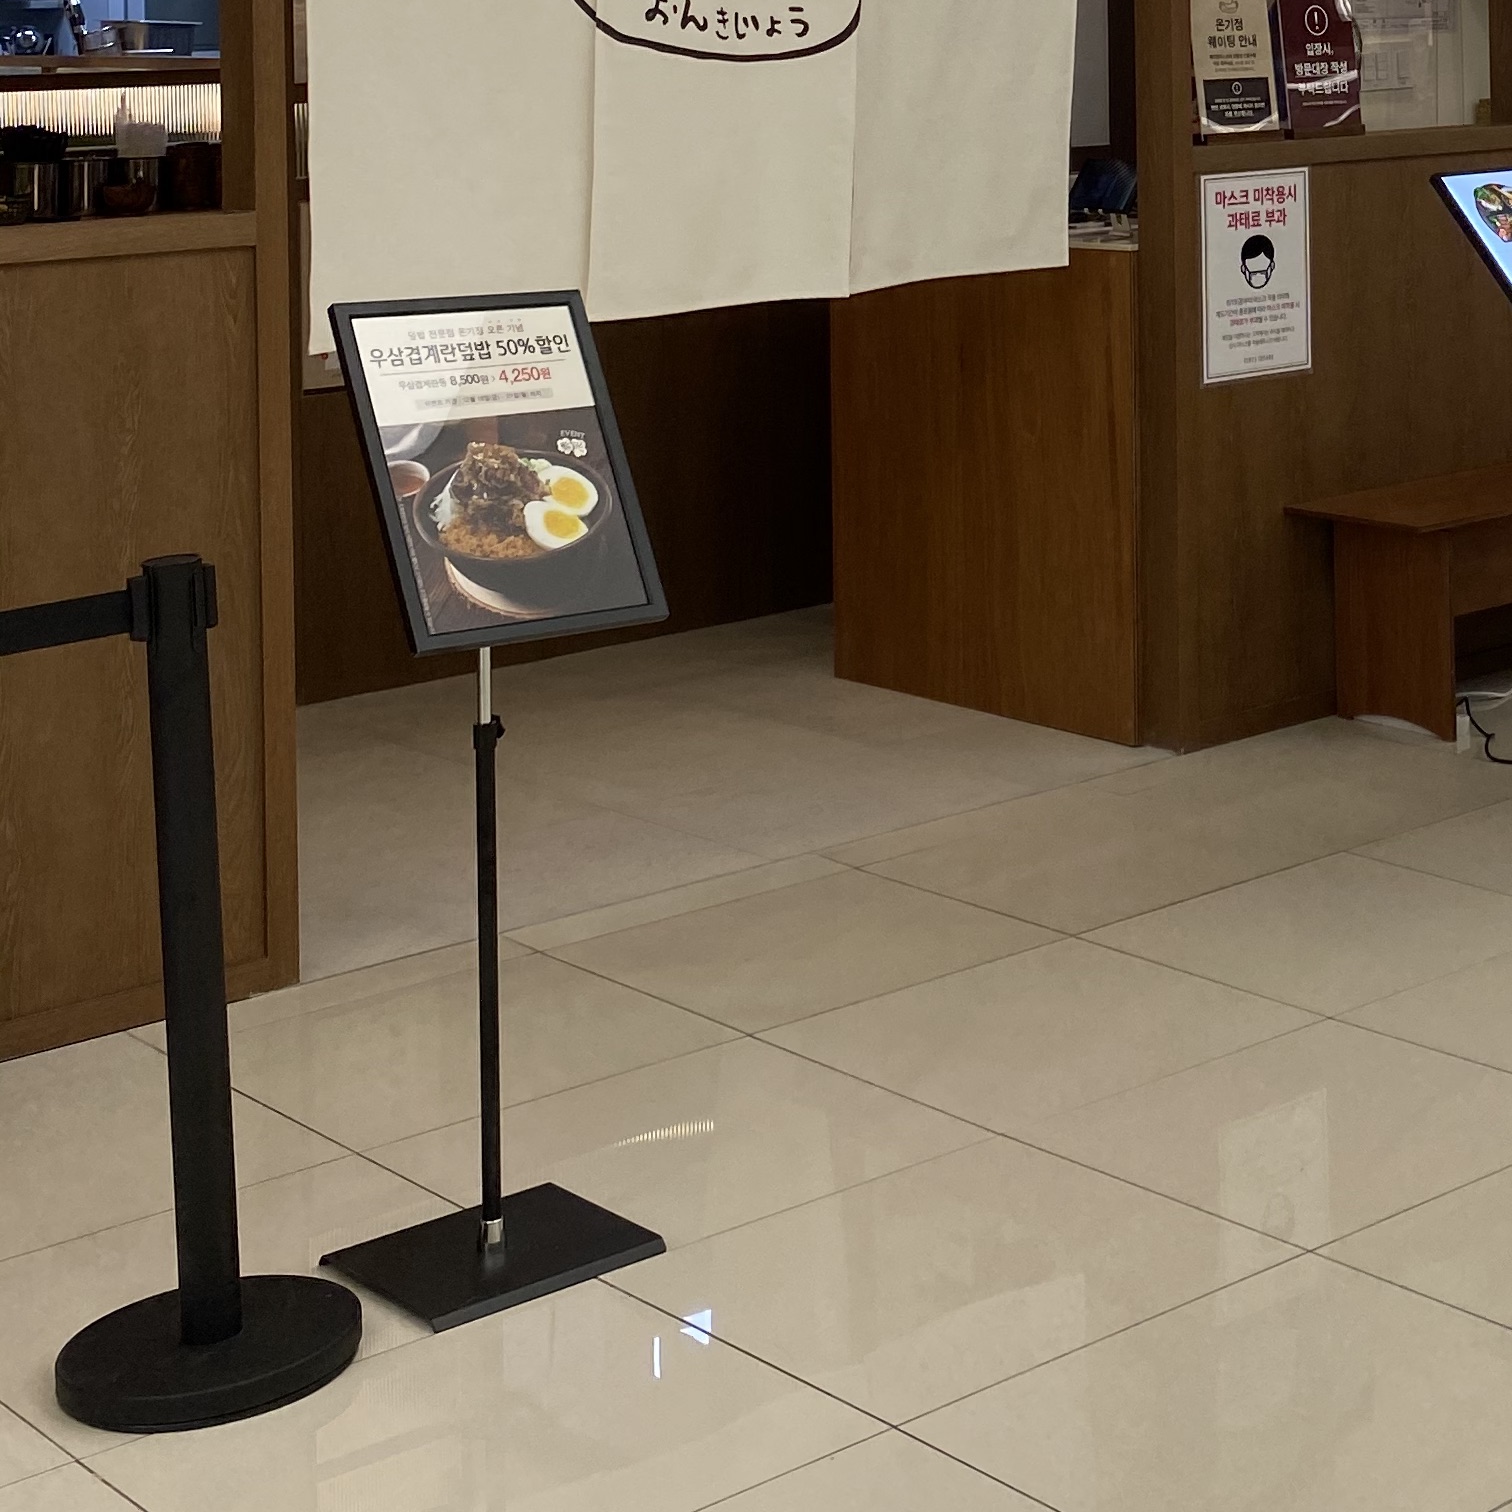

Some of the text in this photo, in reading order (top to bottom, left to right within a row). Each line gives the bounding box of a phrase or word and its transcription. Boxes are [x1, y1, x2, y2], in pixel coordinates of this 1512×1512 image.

[1216, 18, 1243, 32] 온기정
[1207, 34, 1257, 48] 웨이팅 안내
[1330, 61, 1348, 74] 작성
[1215, 184, 1297, 209] 마스크 미착용시
[1227, 208, 1287, 231] 과태료 부과
[370, 334, 571, 369] 우삼겹계란덮밥 50%할인
[499, 366, 552, 385] 4,250원
[560, 429, 585, 439] EVENT
